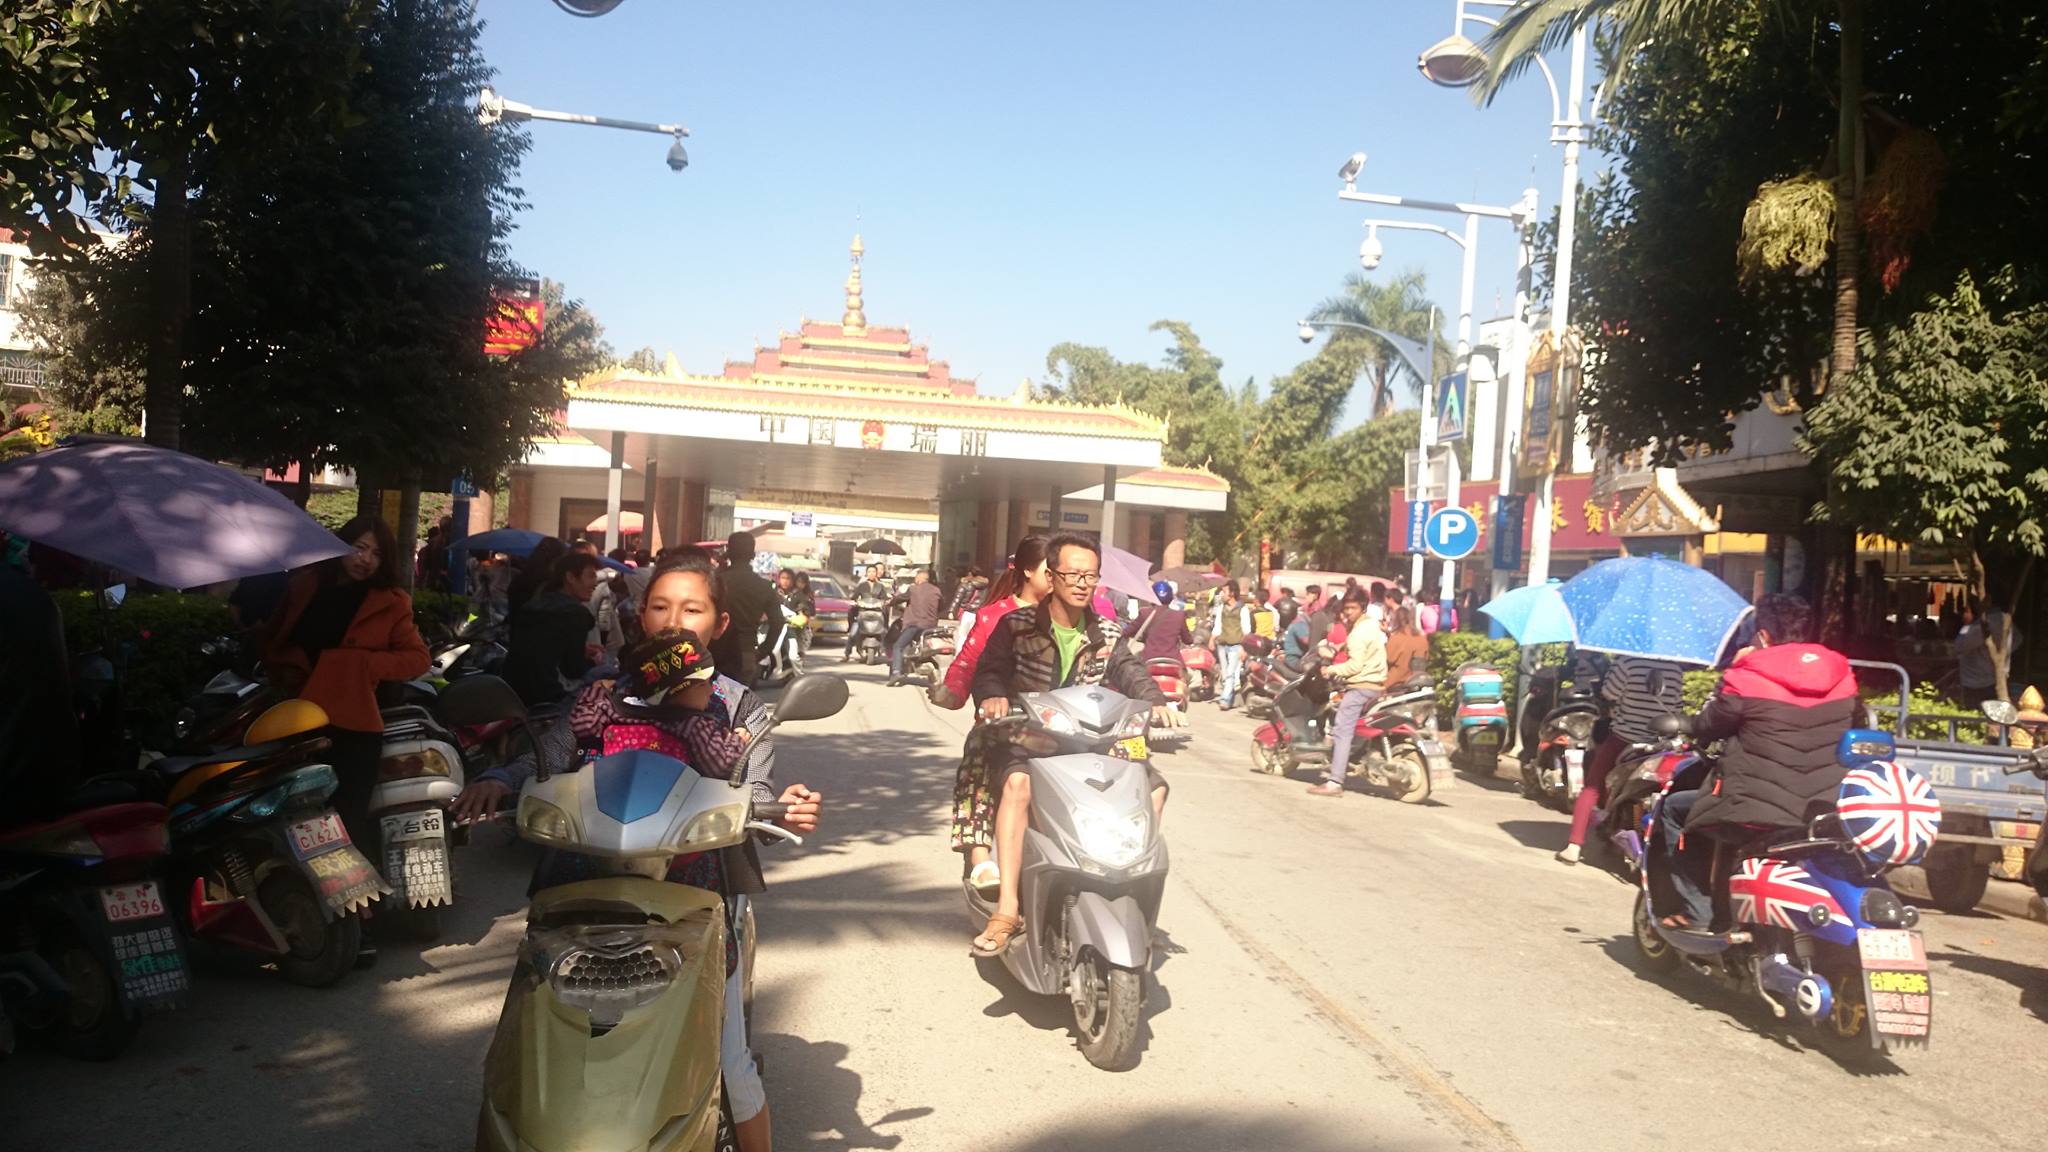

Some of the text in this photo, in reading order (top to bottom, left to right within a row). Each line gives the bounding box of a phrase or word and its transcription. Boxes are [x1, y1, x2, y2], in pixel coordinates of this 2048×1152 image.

[1439, 513, 1467, 545] P
[299, 826, 340, 849] C1621
[110, 898, 160, 919] 06396
